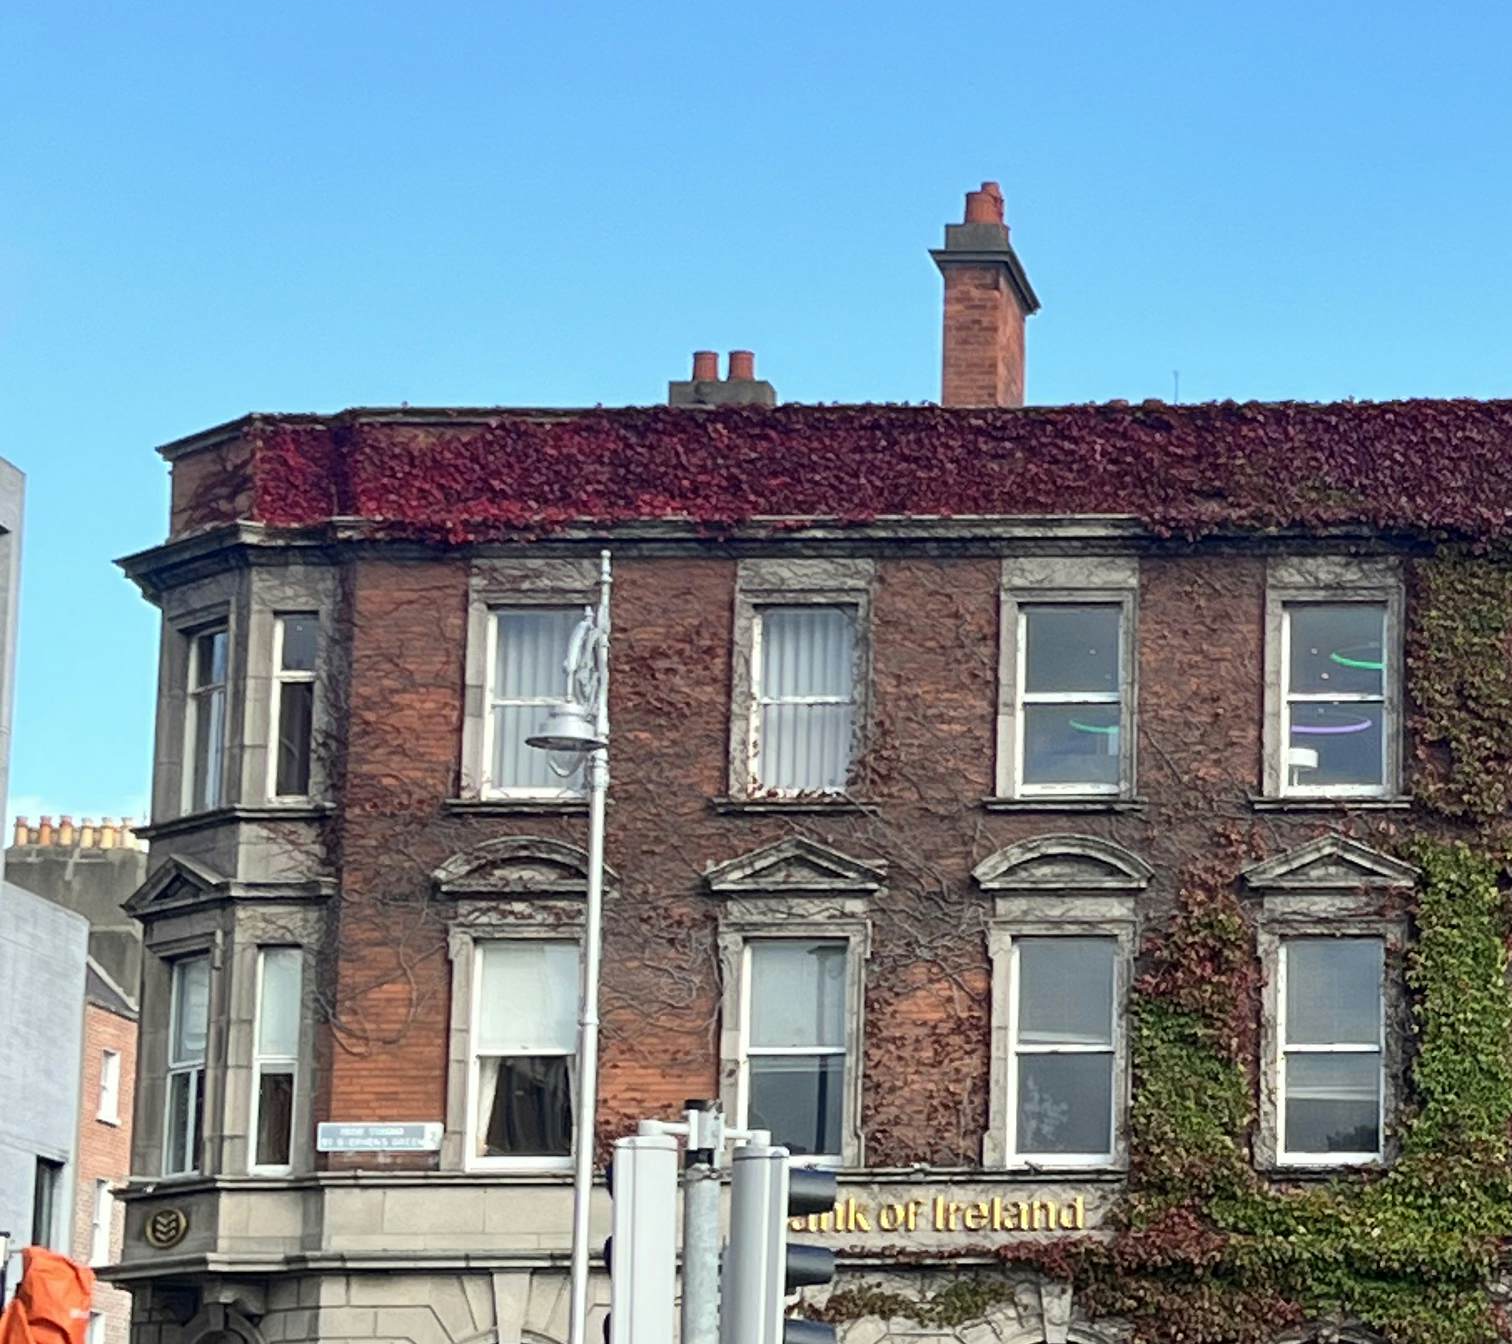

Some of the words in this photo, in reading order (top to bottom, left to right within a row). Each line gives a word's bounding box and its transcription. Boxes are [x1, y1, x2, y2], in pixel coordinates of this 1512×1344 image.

[786, 1196, 872, 1232] ank
[878, 1197, 924, 1232] of
[932, 1194, 1086, 1232] Ireland
